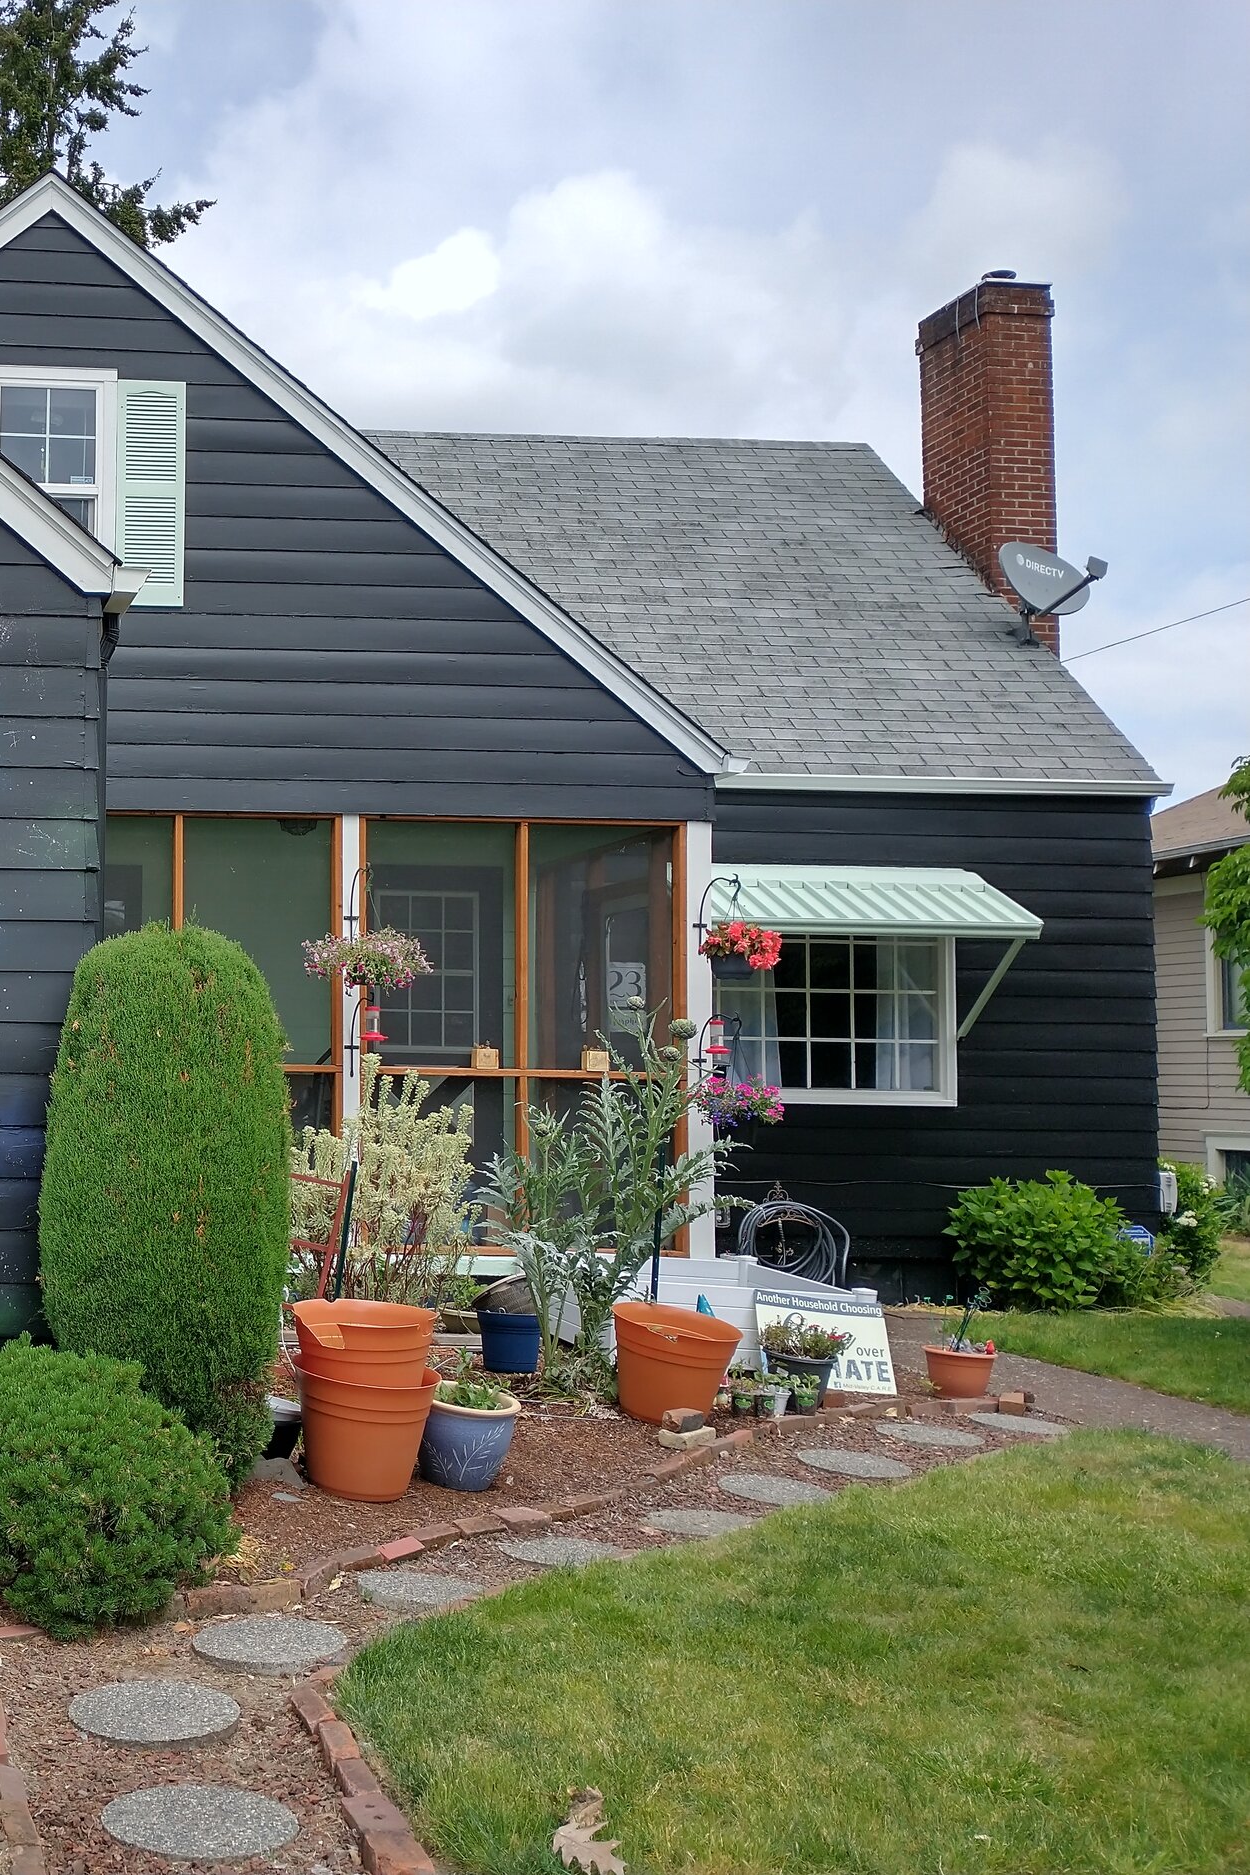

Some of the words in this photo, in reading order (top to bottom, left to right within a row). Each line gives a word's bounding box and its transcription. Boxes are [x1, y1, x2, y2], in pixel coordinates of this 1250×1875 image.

[1025, 558, 1064, 579] DIRECTV
[756, 1291, 790, 1306] Another
[791, 1296, 838, 1311] Household
[840, 1302, 882, 1317] Choosing
[856, 1346, 885, 1357] over
